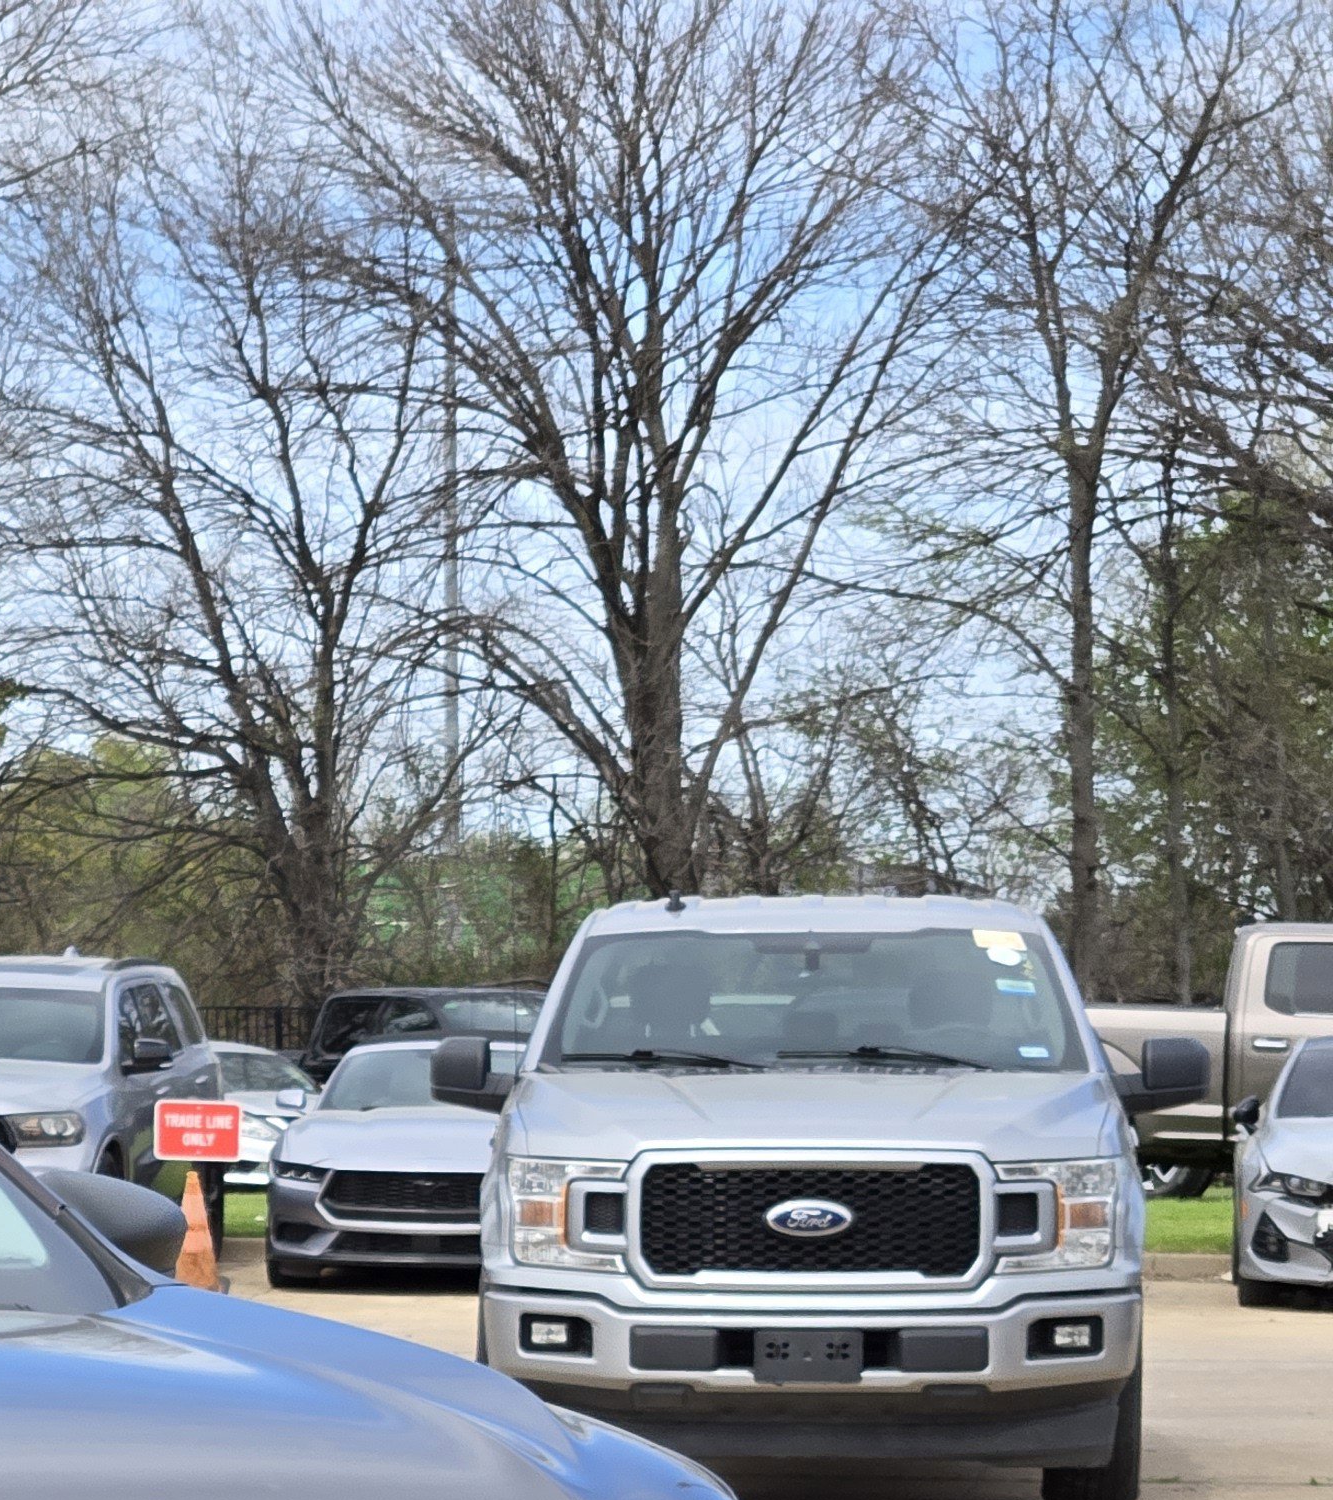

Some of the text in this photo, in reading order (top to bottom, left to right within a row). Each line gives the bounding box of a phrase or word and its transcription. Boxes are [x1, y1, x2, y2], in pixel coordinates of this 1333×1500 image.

[164, 1113, 233, 1130] TRADE LINE
[182, 1132, 217, 1147] ONLY
[787, 1209, 833, 1228] Ford
